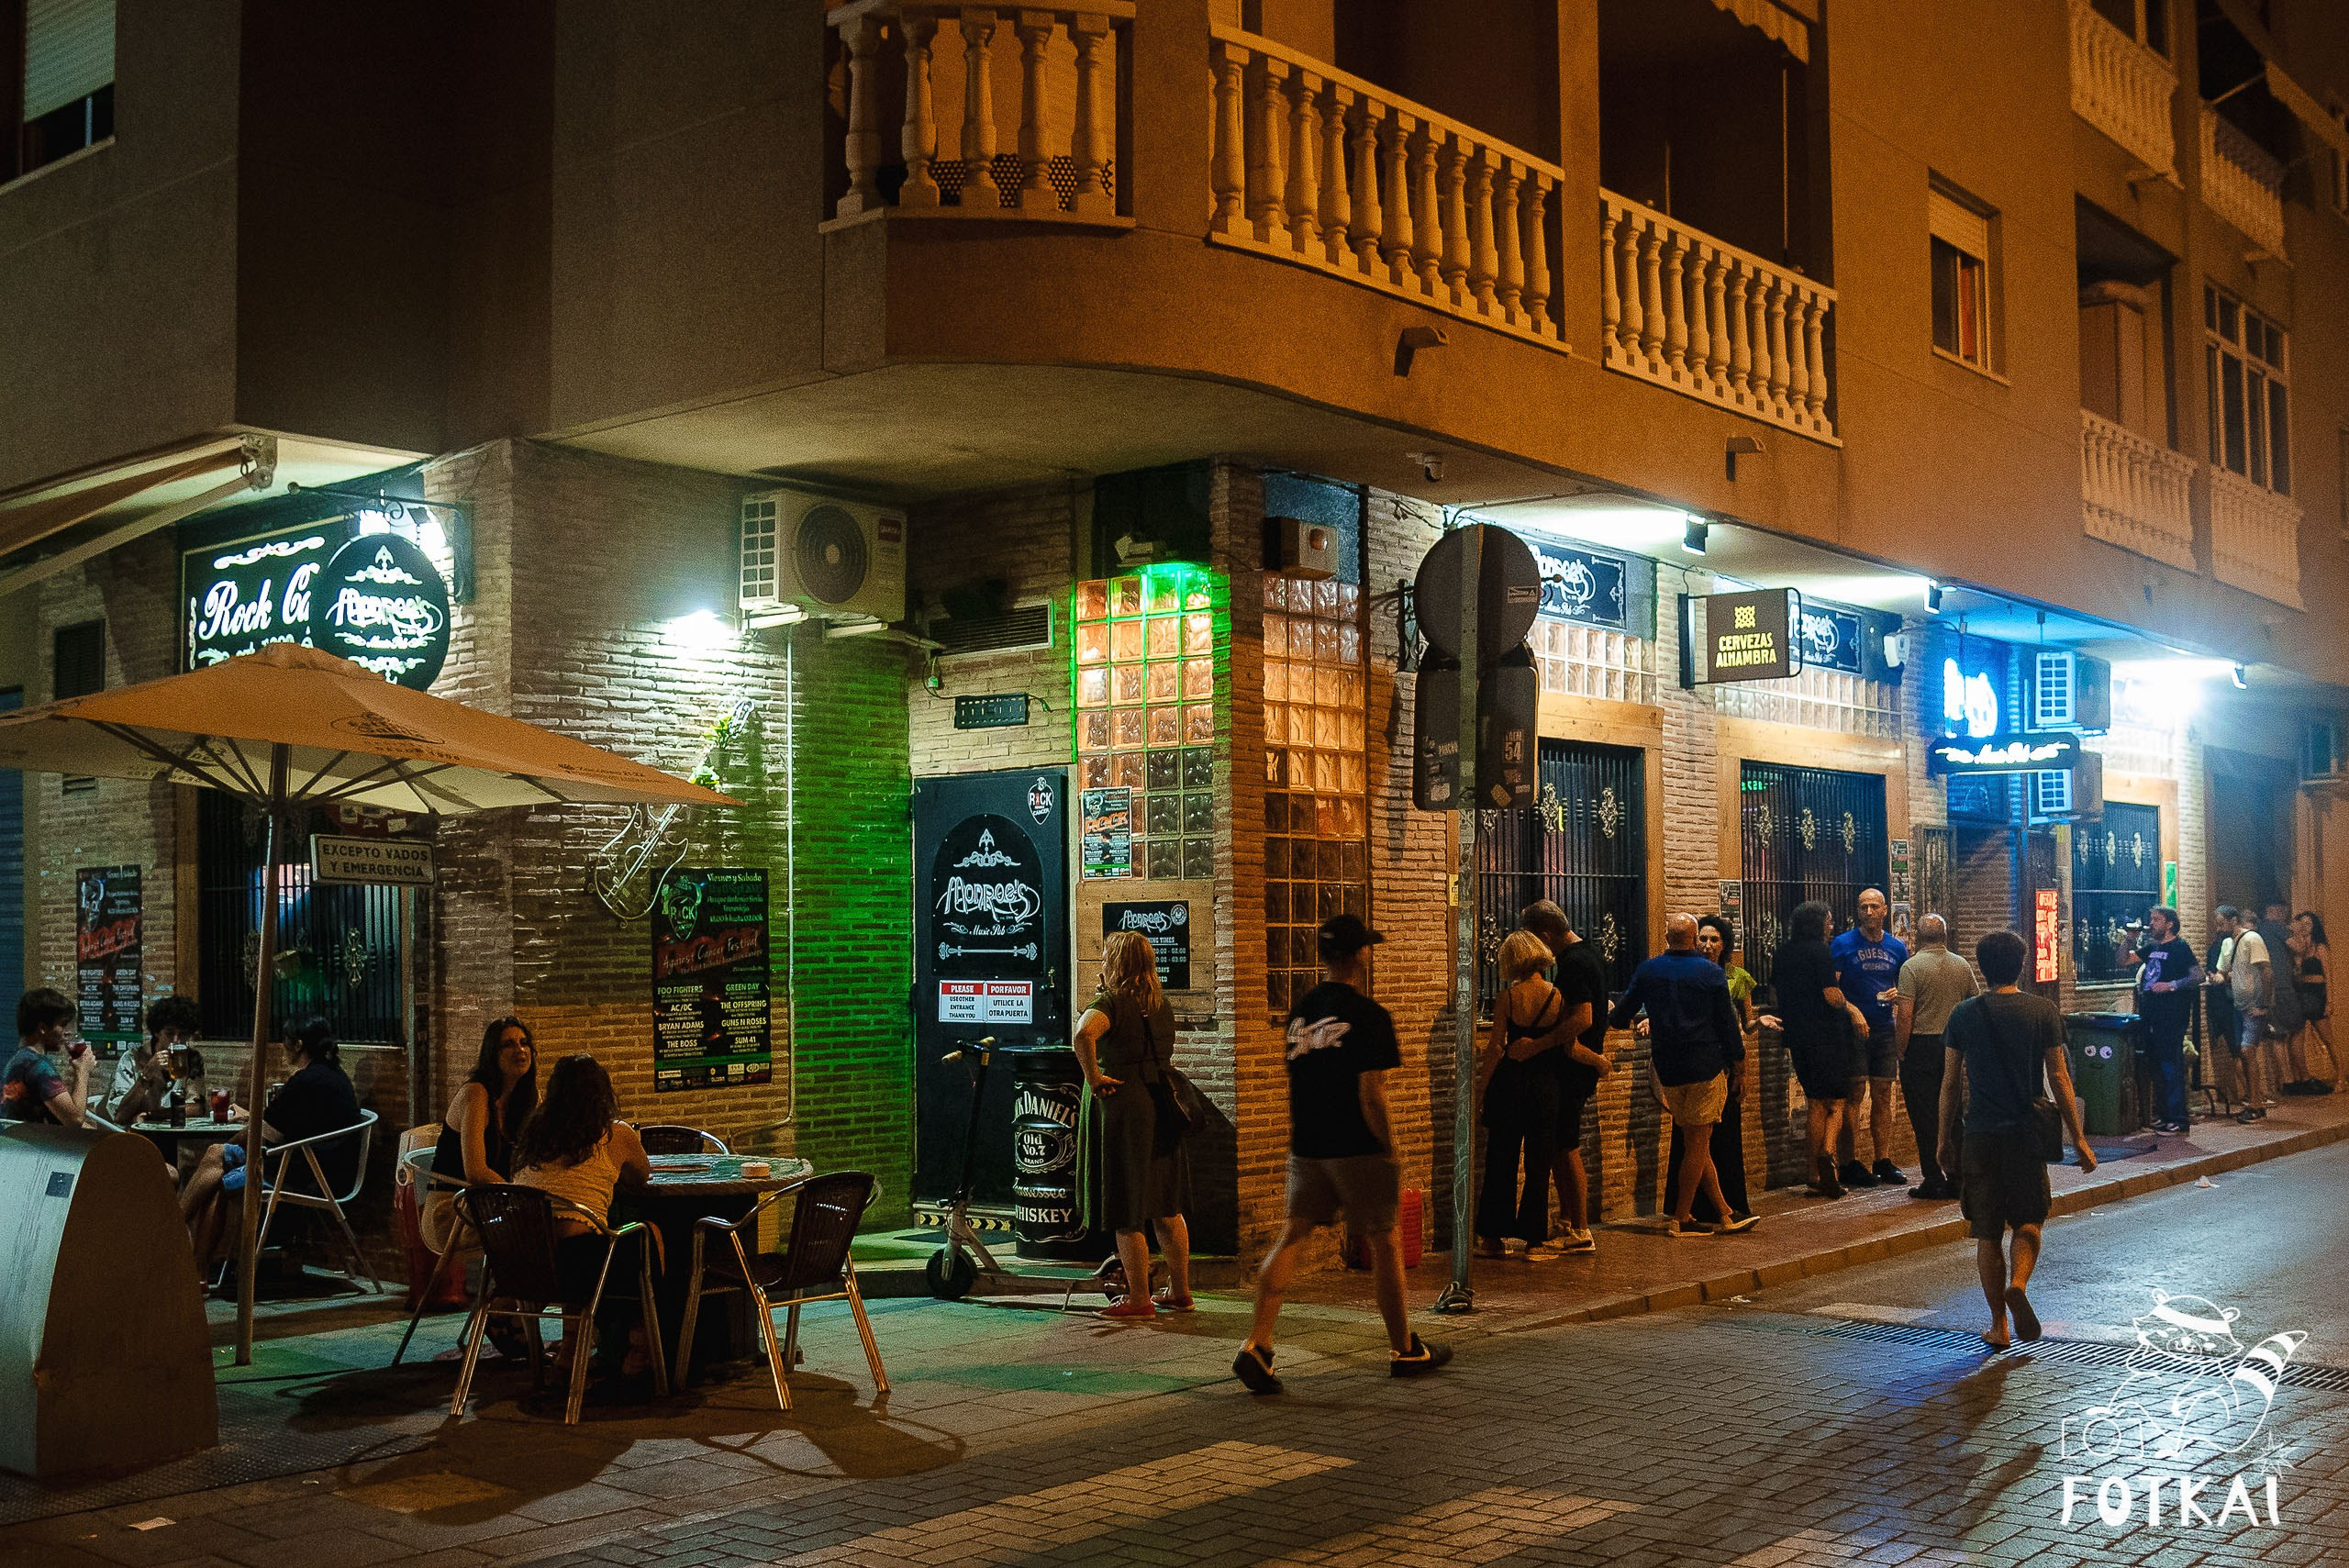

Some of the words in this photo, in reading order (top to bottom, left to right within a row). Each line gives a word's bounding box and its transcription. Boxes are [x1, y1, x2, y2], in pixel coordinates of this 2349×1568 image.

[198, 579, 273, 640] Rock
[1719, 632, 1774, 651] CERVEZAS
[1716, 649, 1777, 668] ALHAMBRA
[322, 844, 381, 859] EXCEPTO
[385, 848, 429, 862] VADOS
[330, 862, 339, 873] Y
[343, 862, 424, 877] EMERGENCIA
[969, 924, 990, 935] Music
[990, 924, 1006, 935] Pub
[1857, 948, 1890, 962] GUESS
[657, 987, 673, 995] FOO
[674, 985, 704, 994] FIGHTERS
[726, 984, 747, 992] GREEN
[747, 983, 760, 991] DAY
[951, 984, 974, 993] PLEASE
[990, 985, 1005, 994] POR
[1005, 985, 1027, 994] FAVOR
[671, 1003, 693, 1012] AC/DC
[732, 1000, 767, 1008] OFFSPRING
[658, 1022, 681, 1031] BRYAN
[681, 1020, 705, 1029] ADAMS
[721, 1018, 740, 1027] GUNS
[746, 1017, 767, 1026] ROSES
[667, 1040, 678, 1049] THE
[680, 1040, 697, 1048] BOSS
[1023, 1133, 1042, 1146] Old
[1023, 1145, 1046, 1156] No.7
[1024, 1157, 1044, 1165] BRAND
